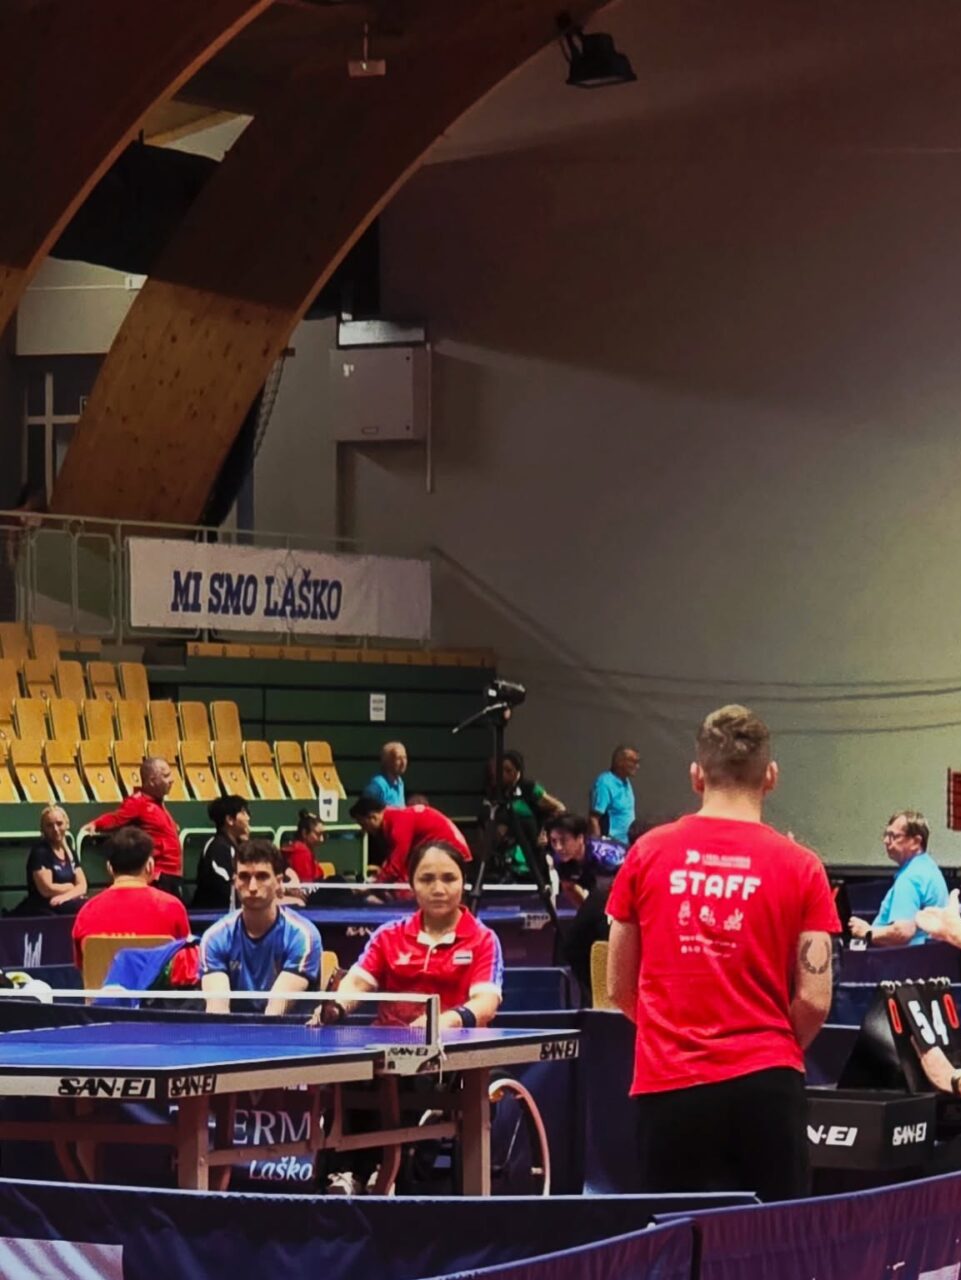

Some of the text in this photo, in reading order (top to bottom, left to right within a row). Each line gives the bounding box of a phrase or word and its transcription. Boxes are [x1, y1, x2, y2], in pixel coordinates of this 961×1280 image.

[171, 568, 342, 620] MI SMO LAŠKO
[669, 869, 762, 901] STAFF
[57, 1077, 151, 1098] SAN-EI
[169, 1074, 216, 1096] SAN-EI
[892, 1122, 927, 1146] SAN-EI
